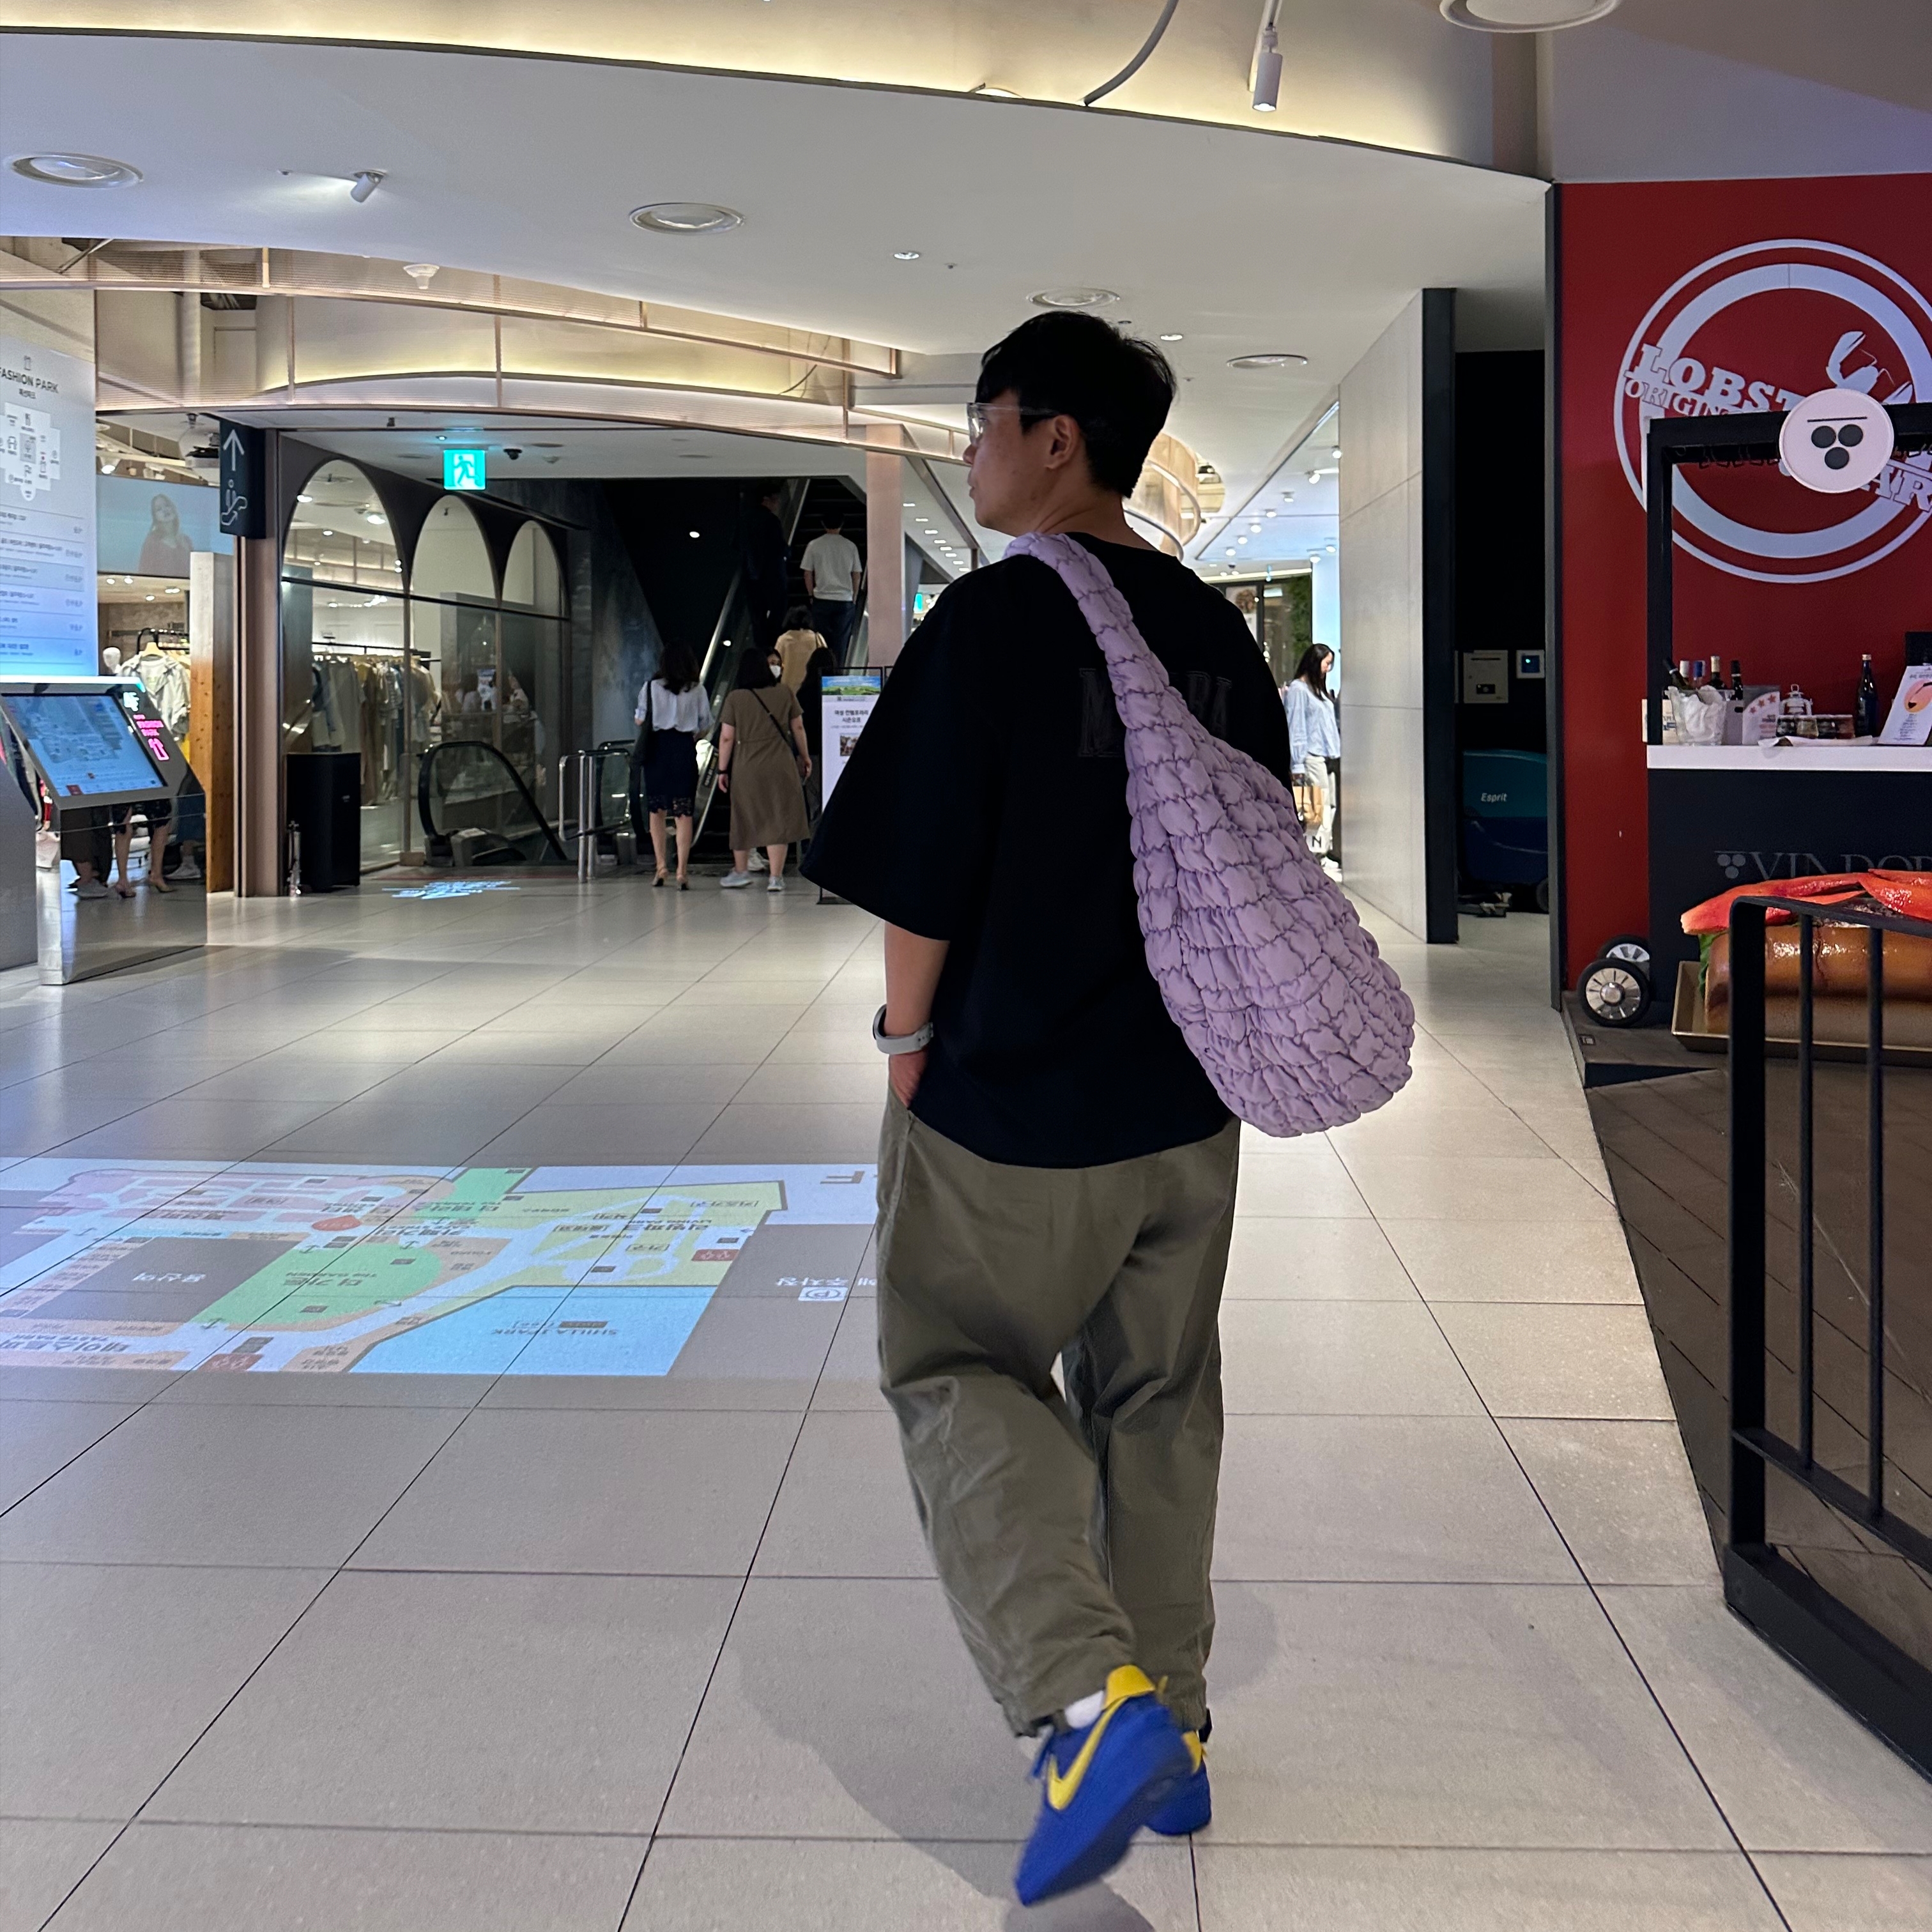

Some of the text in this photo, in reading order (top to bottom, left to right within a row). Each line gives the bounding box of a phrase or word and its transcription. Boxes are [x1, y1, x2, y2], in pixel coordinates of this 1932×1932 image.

[0, 366, 59, 394] ASHION PARK
[1624, 343, 1807, 413] LOBST
[1481, 792, 1507, 803] Esprit
[1752, 852, 1828, 880] VIN
[284, 1277, 333, 1285] 가든
[775, 1277, 848, 1285] 주차장
[0, 1340, 129, 1351] 테이스트파
